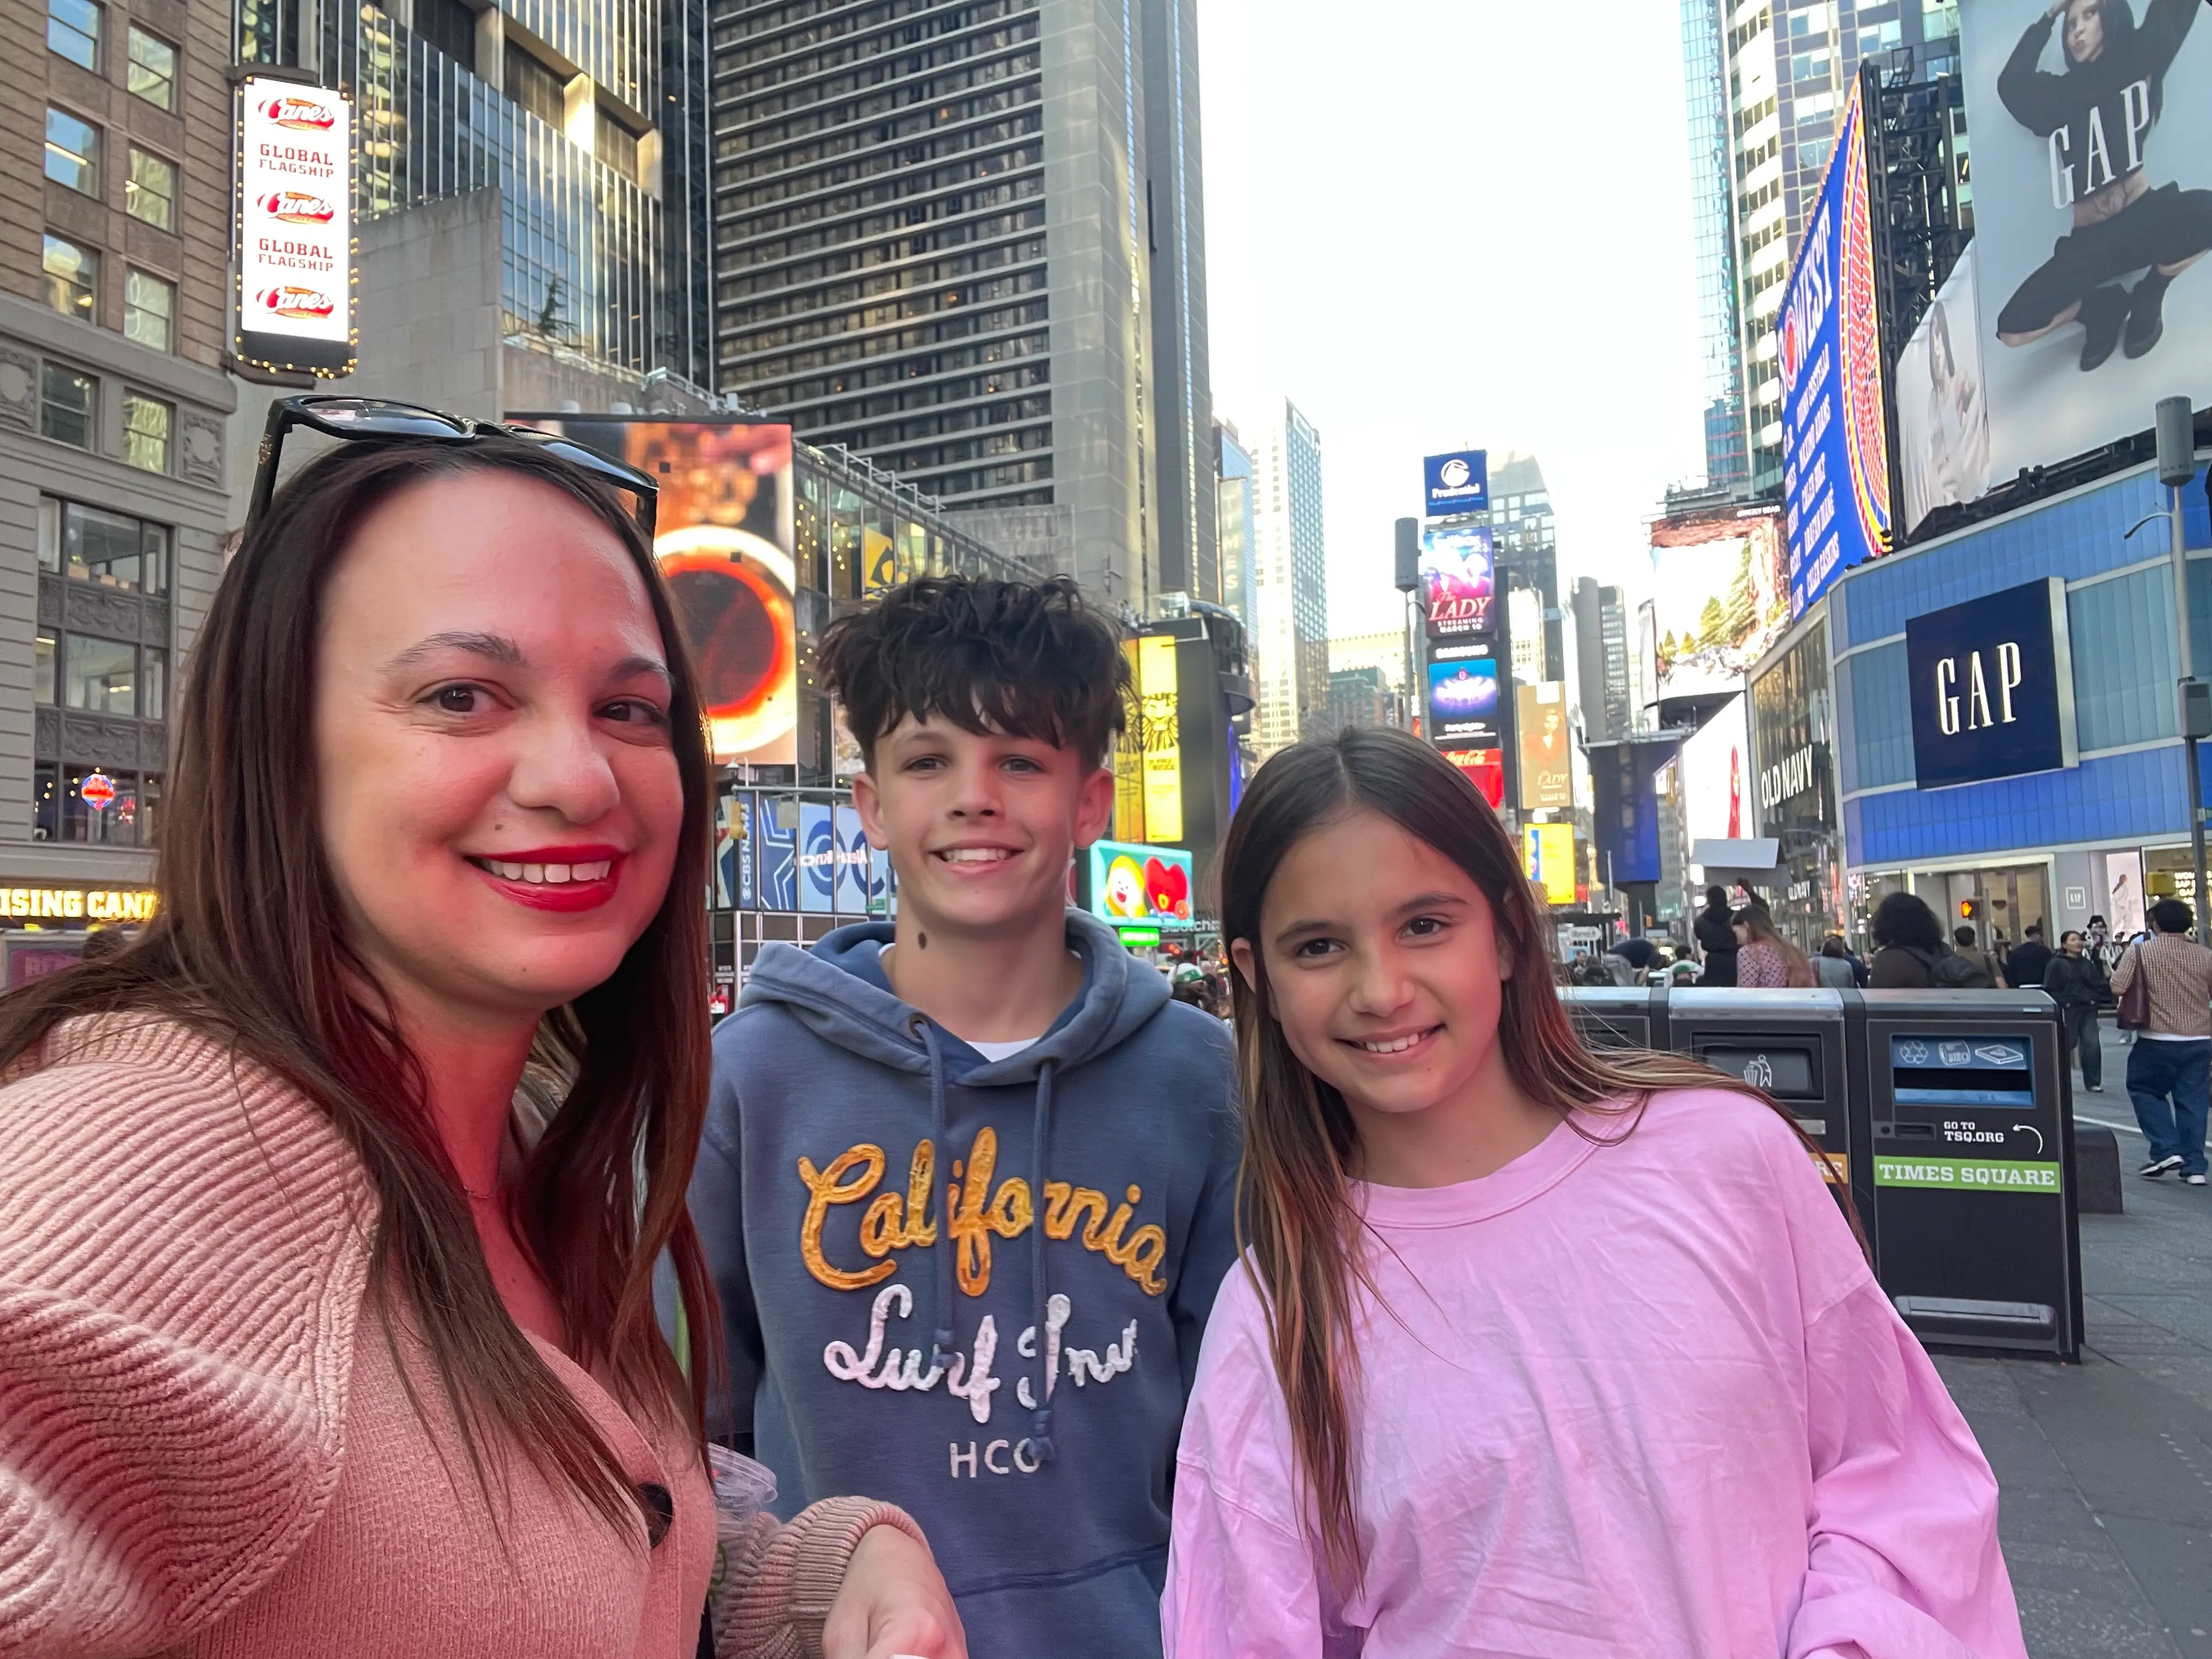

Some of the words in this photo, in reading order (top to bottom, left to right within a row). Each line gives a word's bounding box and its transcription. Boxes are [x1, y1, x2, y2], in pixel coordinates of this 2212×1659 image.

[260, 144, 333, 166] GLOBAL
[2049, 80, 2149, 209] GAP
[259, 159, 334, 178] FLAGSHIP
[259, 238, 332, 259] GLOBAL
[258, 253, 333, 272] FLAGSHIP
[1428, 596, 1492, 621] LADY
[1437, 617, 1485, 627] STREAMING
[1440, 624, 1470, 633] MARCH
[1937, 642, 2022, 735] GAP
[1761, 765, 1781, 809] OLD
[1782, 744, 1813, 800] NAVY
[742, 854, 751, 886] CBS
[2070, 893, 2081, 902] GAP
[1944, 1121, 1958, 1130] GO
[1961, 1121, 1975, 1130] TO
[1944, 1131, 2004, 1143] TSQ.ORG
[1879, 1164, 1954, 1182] TIMES
[1961, 1167, 2055, 1186] SQUARE
[797, 1126, 1168, 1297] California
[823, 1283, 1001, 1424] Surf
